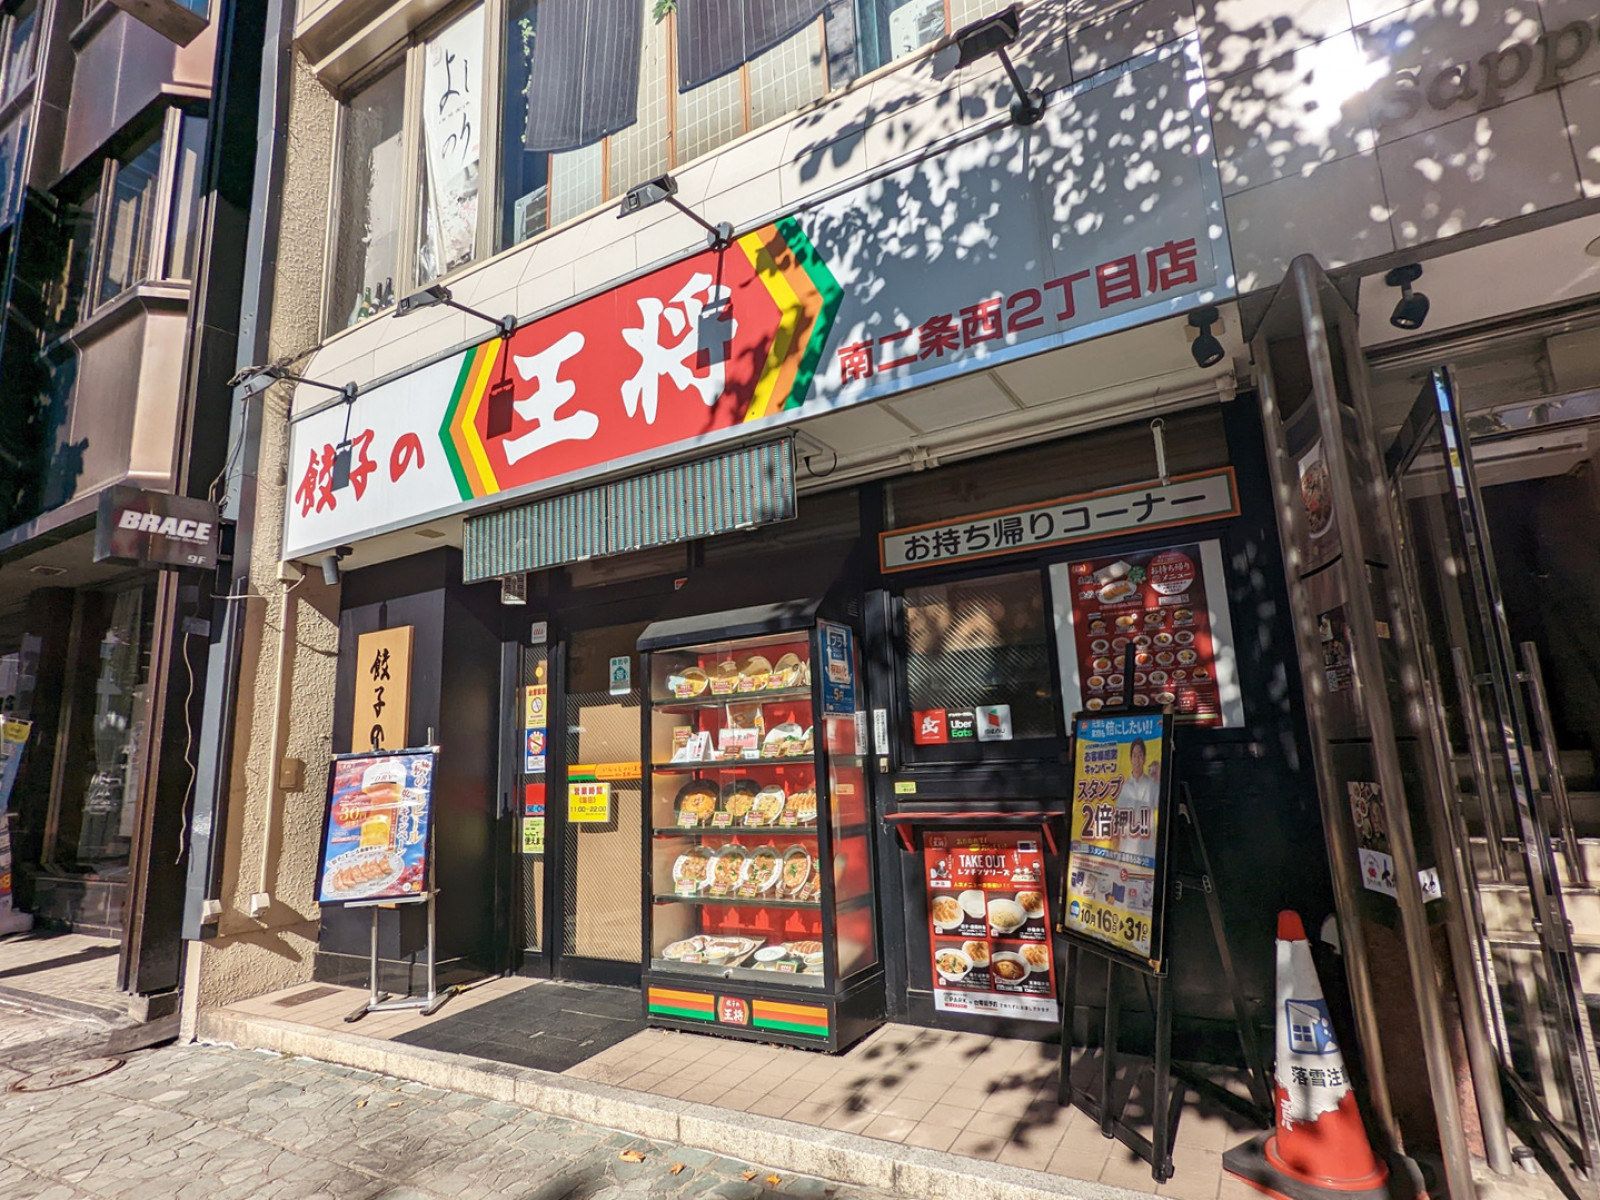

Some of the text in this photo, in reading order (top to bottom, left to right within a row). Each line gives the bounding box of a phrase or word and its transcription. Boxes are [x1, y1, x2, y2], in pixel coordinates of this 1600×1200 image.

[1382, 19, 1600, 122] sapp
[837, 238, 1199, 386] 南二条西2丁目店
[296, 272, 739, 519] 餃子の 王将
[118, 509, 212, 541] BRACE
[904, 492, 1207, 562] お持ち帰りコーナー
[186, 554, 208, 565] 9F
[950, 719, 973, 729] Uber
[951, 729, 973, 738] Eats
[1084, 763, 1118, 775] キャンペーン
[573, 786, 604, 796] 営業時間
[1077, 774, 1124, 801] スタンプ
[958, 854, 1006, 869] TAKE OUT
[723, 1008, 745, 1022] 王将
